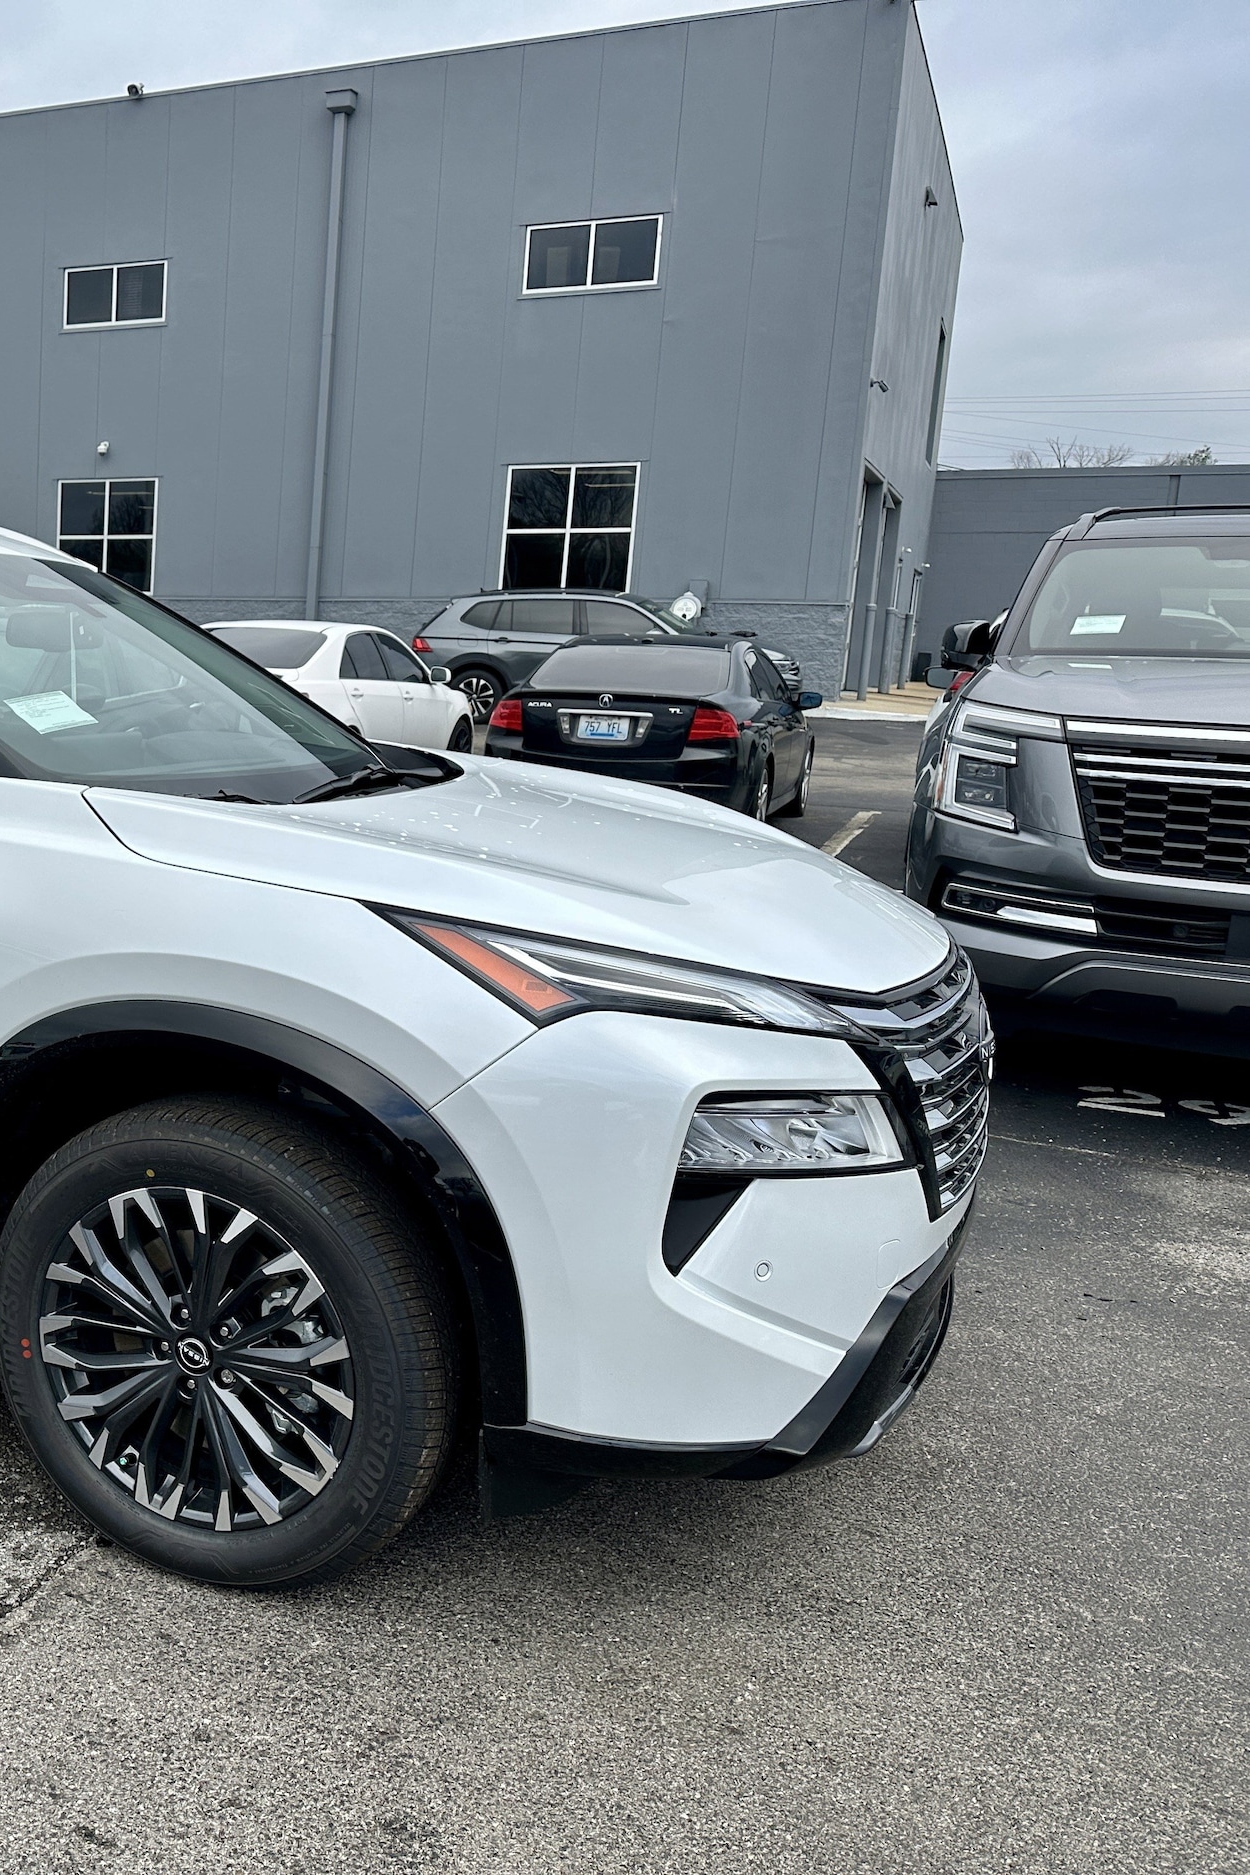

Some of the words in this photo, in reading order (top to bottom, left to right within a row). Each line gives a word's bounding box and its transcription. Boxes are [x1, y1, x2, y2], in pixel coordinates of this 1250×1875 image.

[584, 720, 601, 734] 757
[607, 721, 623, 734] YFL
[177, 1341, 210, 1366] NISSAN
[351, 1291, 396, 1517] BRIDGESTONE
